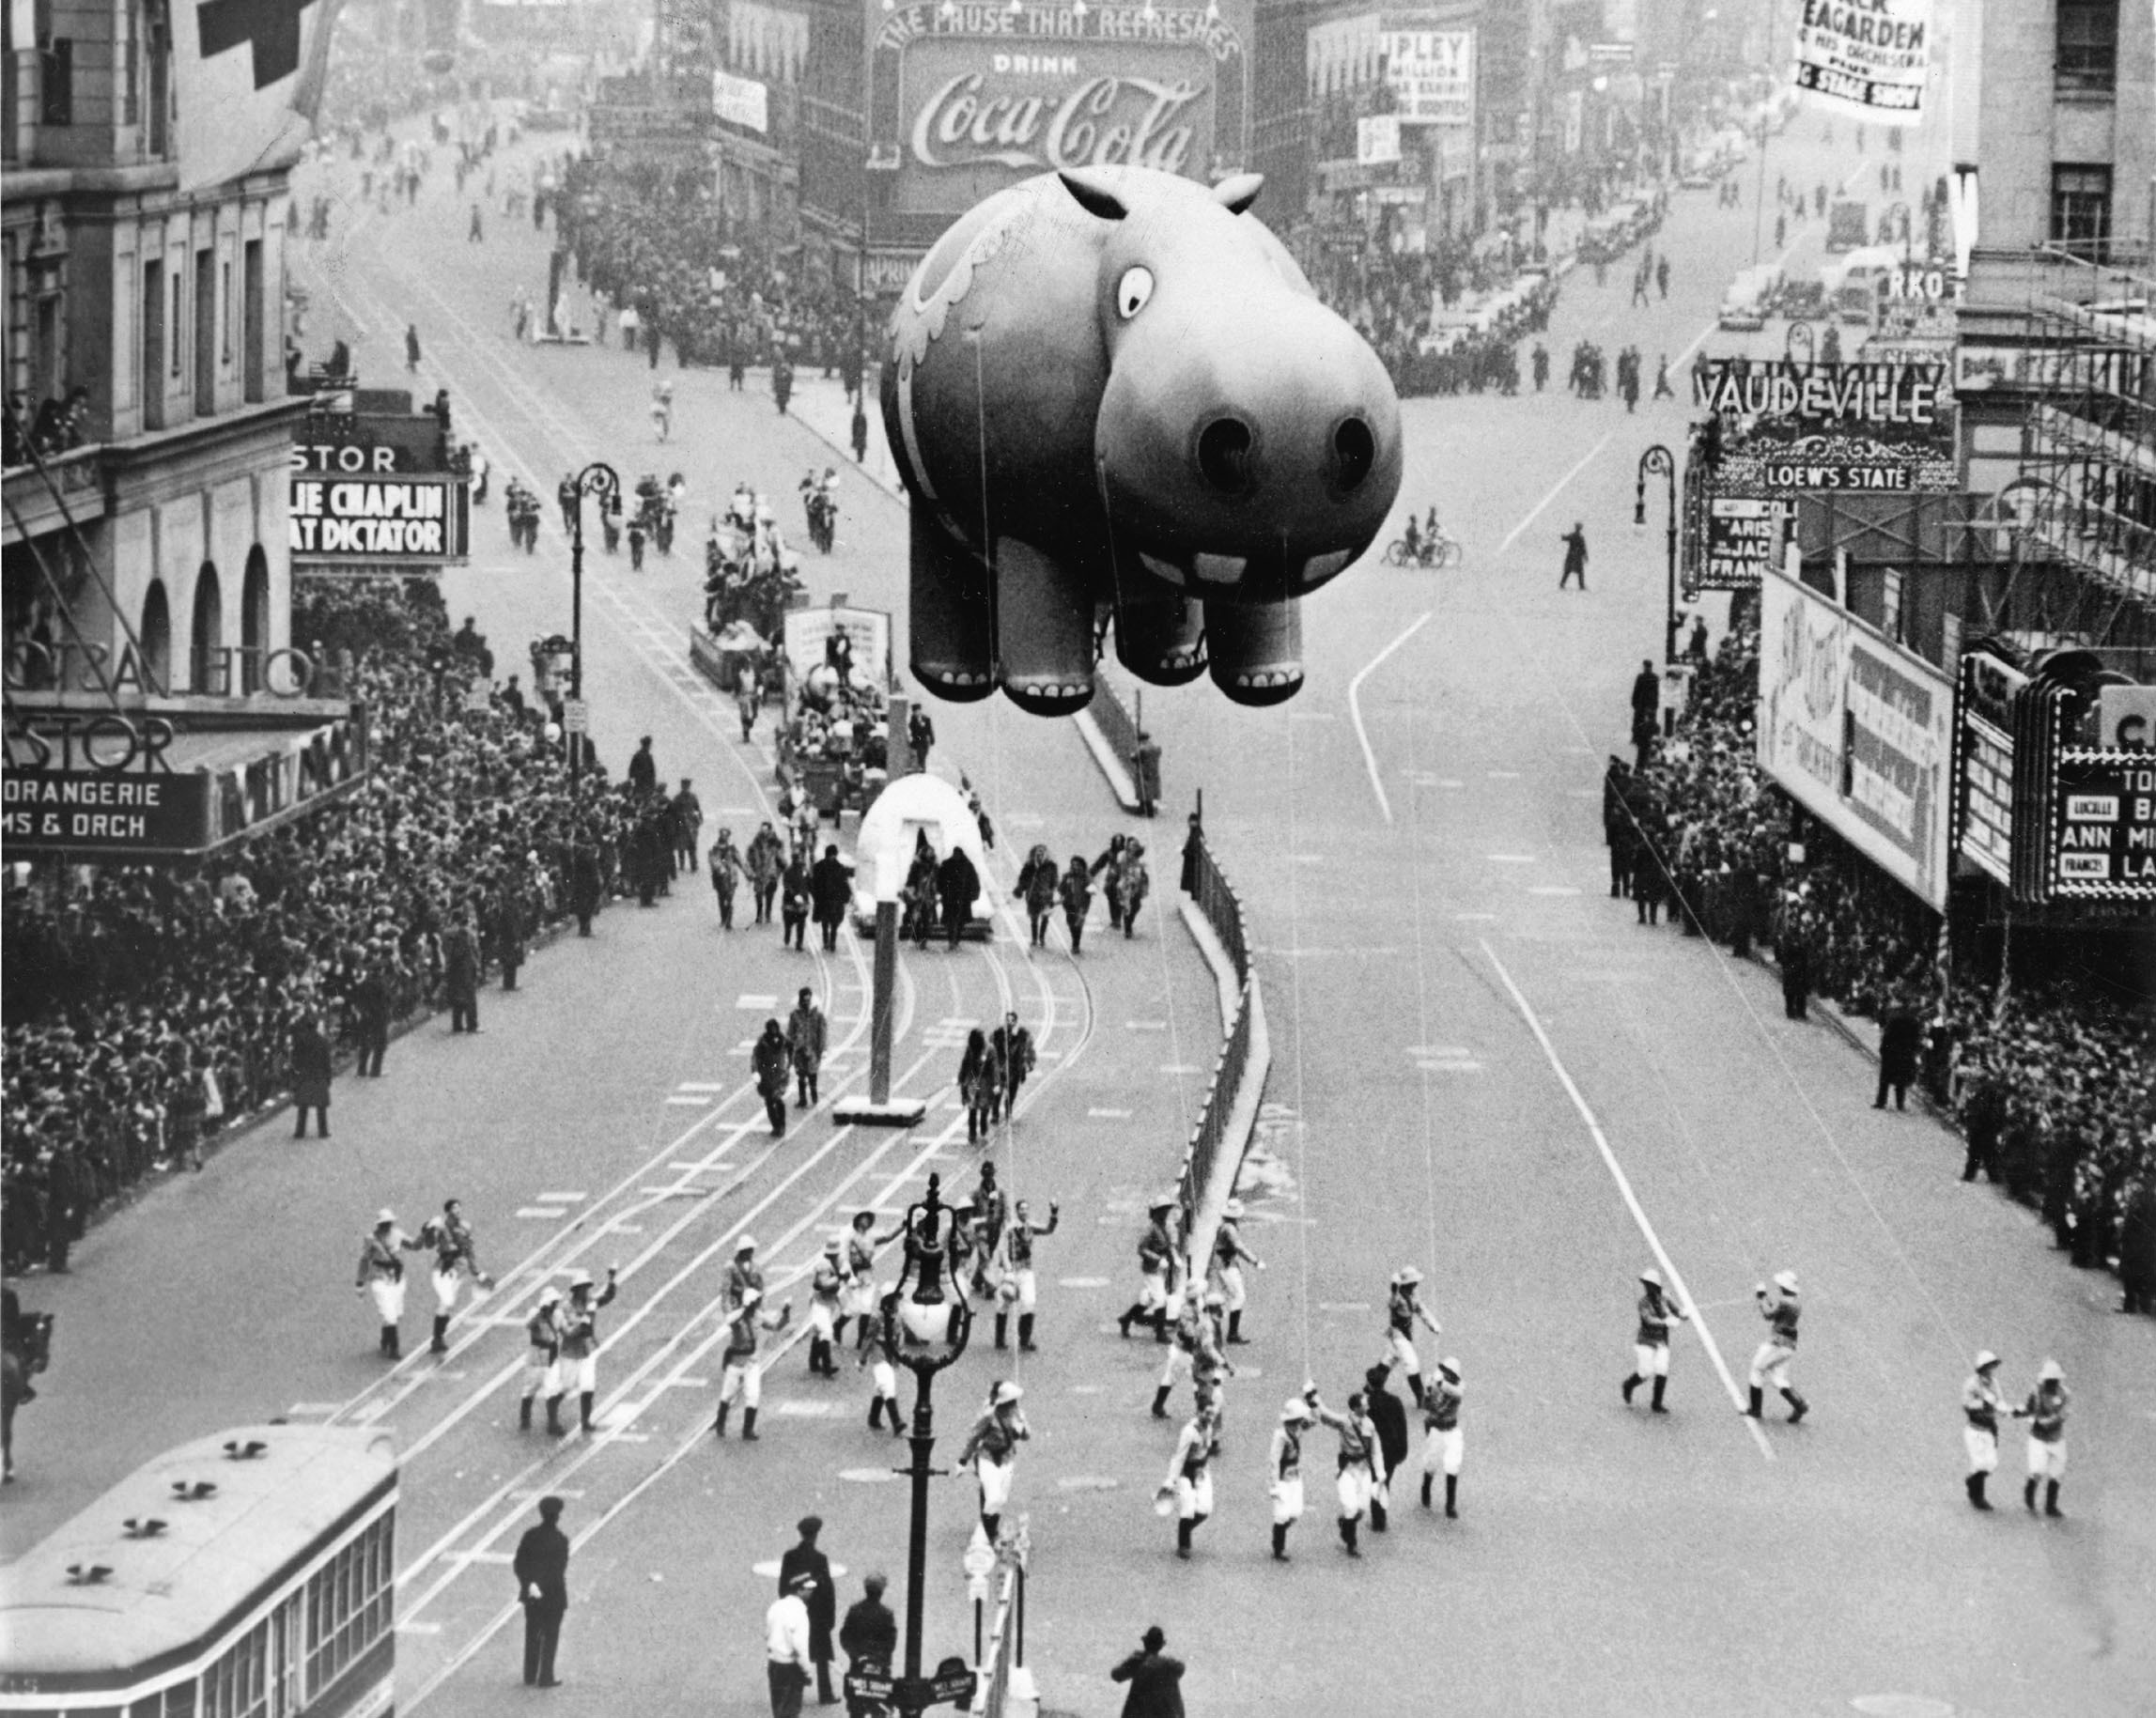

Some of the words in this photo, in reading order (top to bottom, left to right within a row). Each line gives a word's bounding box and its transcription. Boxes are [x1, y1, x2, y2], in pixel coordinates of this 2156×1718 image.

[876, 7, 926, 50] THE
[934, 8, 1016, 35] PAUSE
[1029, 8, 1089, 38] THAT
[1099, 8, 1240, 62] REFRESHES
[993, 54, 1078, 74] DRINK
[1816, 70, 1869, 101] STAGE
[1889, 271, 1943, 299] RKO
[1696, 373, 1934, 424] VAUDEVILLE
[290, 445, 396, 472] STOR
[1768, 466, 1840, 488] LOEW'S
[1848, 468, 1907, 488] STATE
[330, 483, 443, 518] CHAPLIN
[321, 518, 442, 552] DICTATOR
[4, 781, 161, 807] ORANGERIE
[2109, 769, 2156, 792] "TO
[42, 813, 61, 836] &
[72, 814, 145, 838] ORCH
[2062, 826, 2112, 848] ANN
